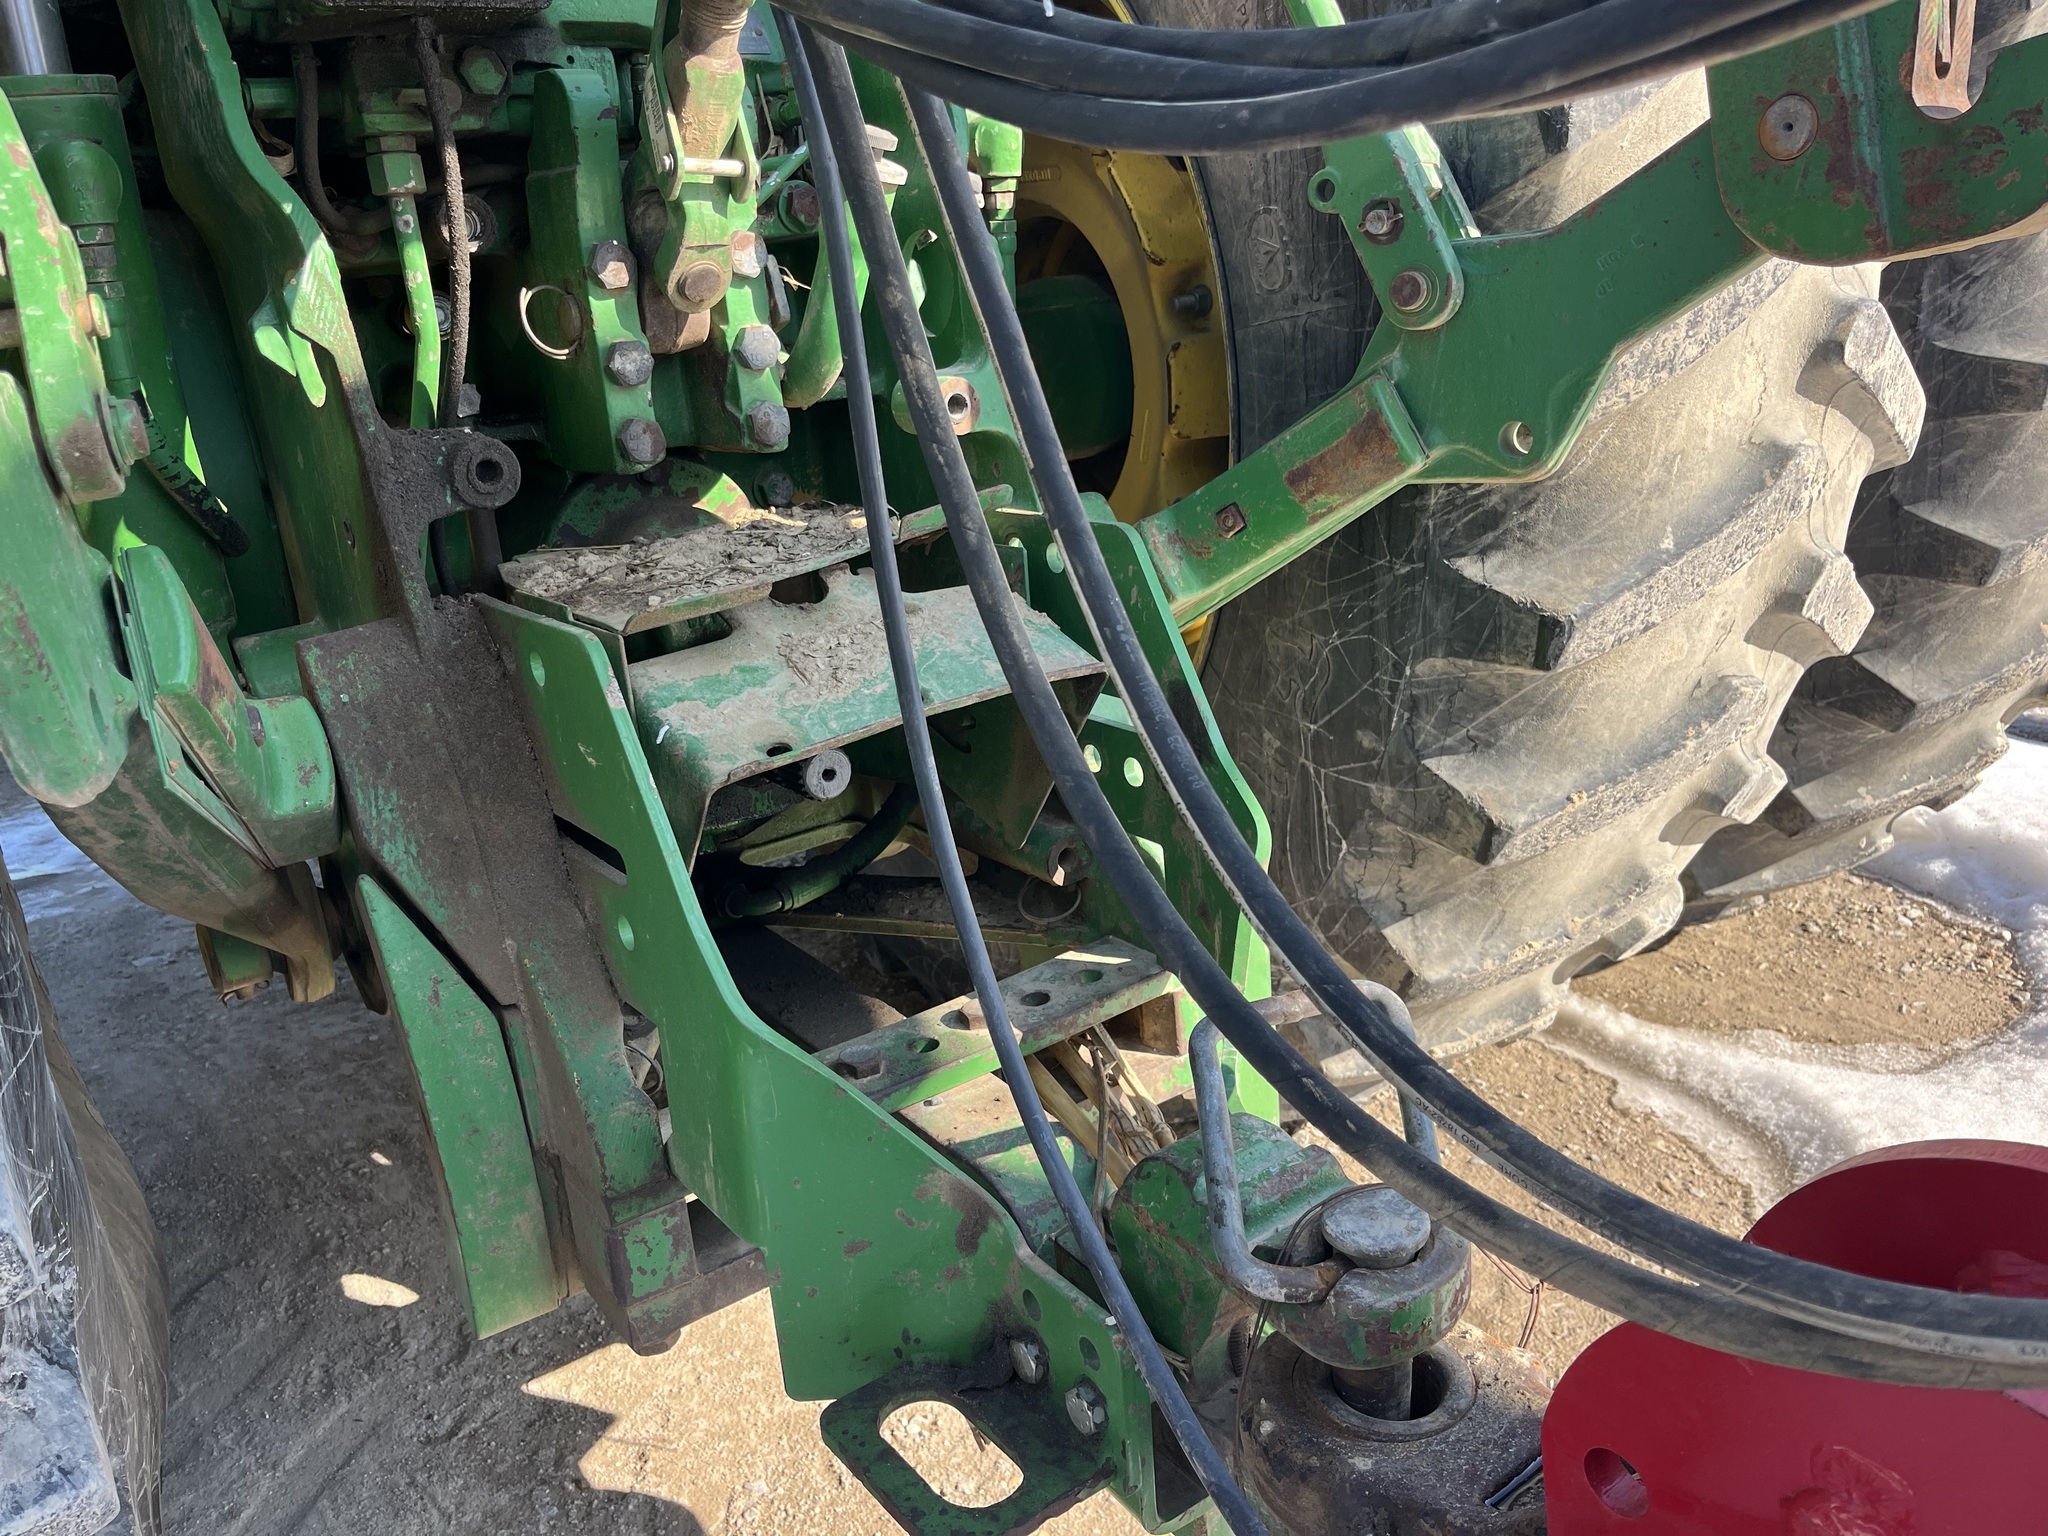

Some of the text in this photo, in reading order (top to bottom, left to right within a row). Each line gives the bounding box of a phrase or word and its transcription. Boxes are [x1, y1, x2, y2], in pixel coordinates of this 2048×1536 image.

[749, 352, 776, 363] 10.9
[1414, 1096, 1459, 1136] 18752-AC
[1461, 1133, 1480, 1152] ISO
